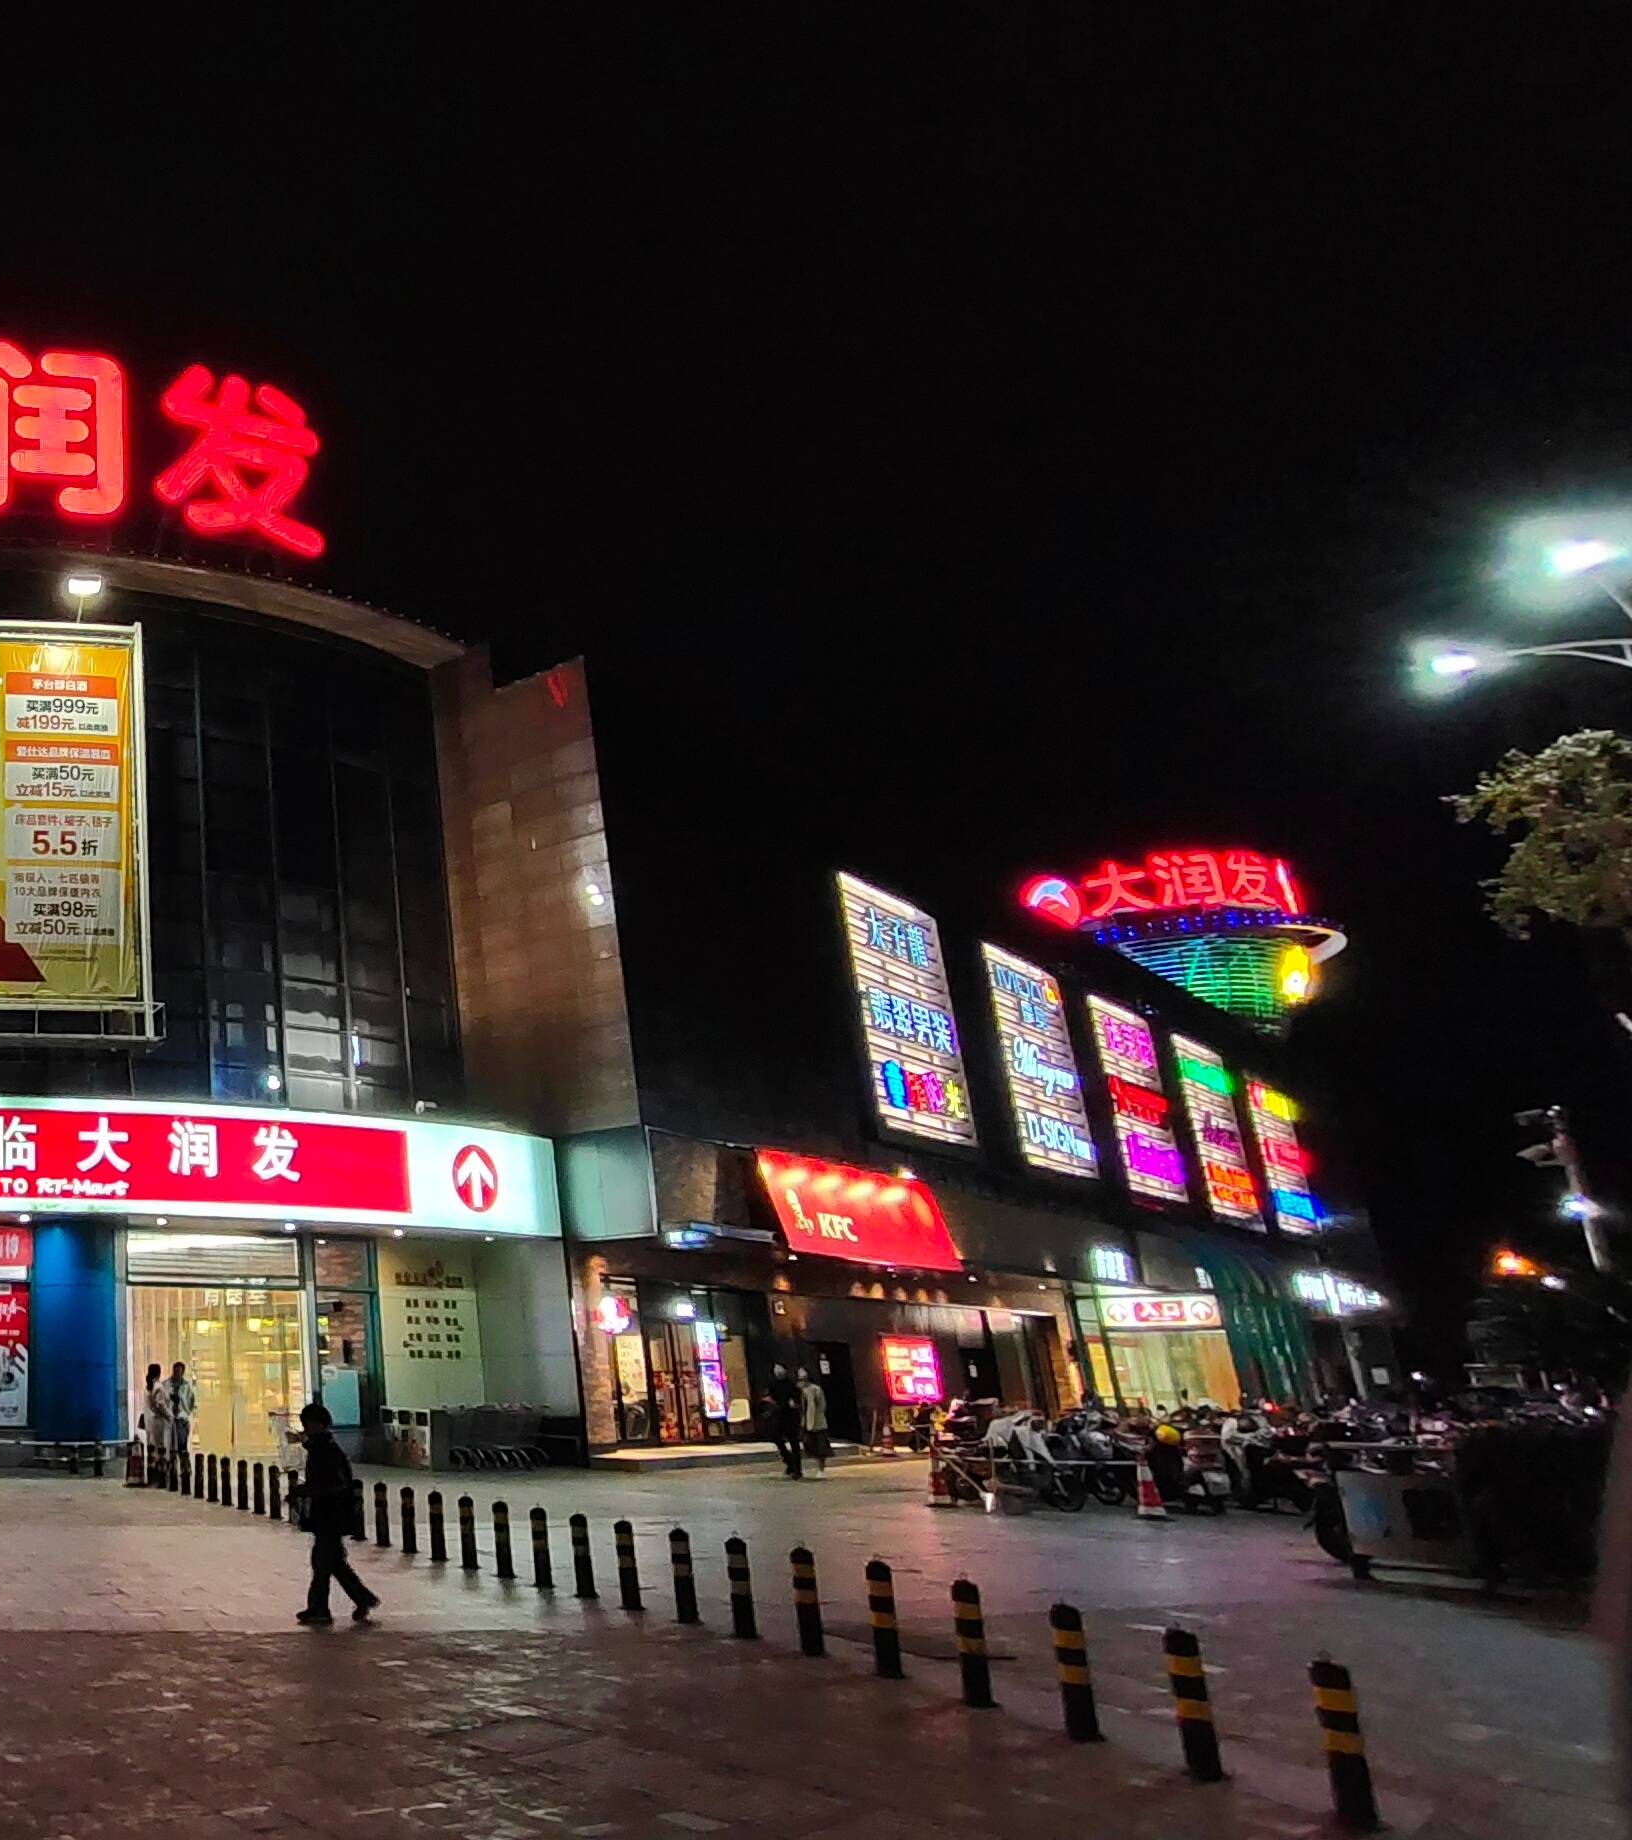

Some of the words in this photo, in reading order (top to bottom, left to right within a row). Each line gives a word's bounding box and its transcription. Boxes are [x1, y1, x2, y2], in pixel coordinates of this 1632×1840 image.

[26, 698, 99, 715] 买满999元
[32, 765, 95, 781] 买满50元
[1085, 853, 1277, 917] 大润发
[33, 901, 98, 919] 买满98元
[0, 1178, 29, 1194] TO
[36, 1177, 129, 1196] RT-Mart
[816, 1212, 858, 1243] KFC
[1139, 1302, 1181, 1318] 入口
